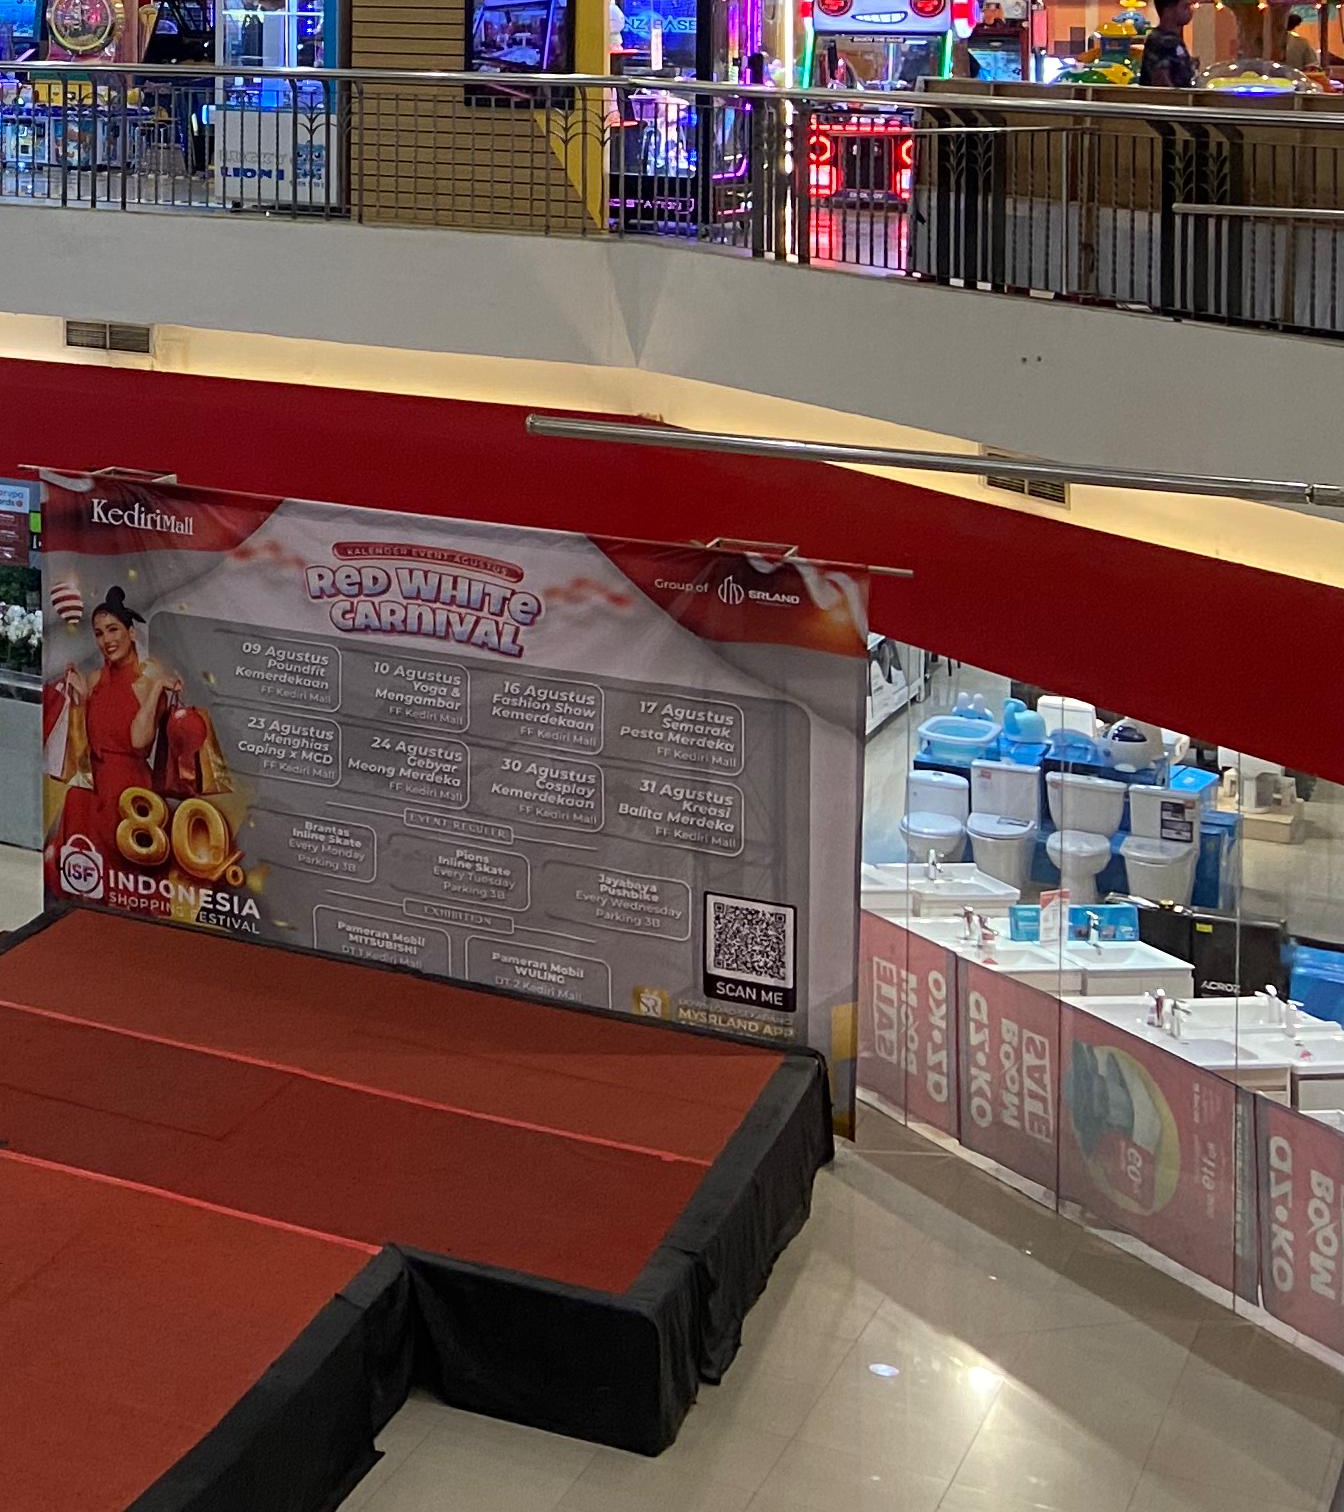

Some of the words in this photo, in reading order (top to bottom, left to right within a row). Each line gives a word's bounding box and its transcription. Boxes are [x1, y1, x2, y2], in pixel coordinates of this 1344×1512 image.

[655, 578, 693, 593] Group
[696, 582, 709, 593] of
[242, 642, 261, 654] 09
[265, 645, 329, 666] Agustus
[235, 666, 329, 689] Kemerdekaan
[268, 659, 326, 676] Poundfit
[374, 662, 390, 673] 10
[393, 665, 461, 686] Agustus
[261, 686, 273, 695] FF
[276, 687, 307, 699] Kediri
[309, 692, 332, 704] Mall
[375, 688, 461, 711] Mengambar
[413, 681, 447, 697] Yoga
[451, 687, 461, 697] &
[503, 681, 520, 694] 16
[524, 684, 595, 705] Agustus
[389, 706, 402, 715] FF
[405, 708, 437, 720] Kediri
[440, 712, 462, 725] Mall
[492, 694, 550, 711] Fashion
[555, 703, 596, 718] Show
[639, 701, 658, 714] 17
[661, 704, 734, 726] Agustus
[247, 717, 265, 729] 23
[269, 720, 334, 741] Agustus
[491, 706, 594, 731] Kemerdekaan
[662, 719, 731, 737] Semarak
[263, 733, 329, 752] Menghias
[520, 727, 533, 736] FF
[537, 728, 571, 742] Kediri
[575, 734, 596, 747] Mall
[620, 726, 663, 740] Pesta
[667, 733, 735, 752] Merdeka
[238, 741, 286, 760] Caping
[289, 751, 297, 759] x
[301, 751, 333, 765] MCD
[371, 737, 391, 749] 24
[395, 740, 462, 761] Agustus
[657, 747, 670, 756] FF
[673, 749, 708, 762] Kediri
[712, 754, 737, 767] Mall
[263, 760, 274, 768] FF
[279, 762, 310, 775] Kediri
[312, 767, 335, 779] Mall
[347, 758, 395, 777] Meong
[399, 766, 461, 787] Merdeka
[407, 756, 458, 773] Gebyar
[501, 759, 521, 772] 30
[525, 762, 596, 784] Agustus
[491, 784, 594, 809] Kemerdekaan
[535, 779, 596, 798] Cosplay
[639, 780, 656, 792] 31
[659, 784, 733, 806] Agustus
[619, 804, 662, 821] Balita
[667, 812, 735, 832] Merdeka
[682, 802, 731, 818] Kreasi
[292, 828, 327, 842] Inline
[328, 836, 362, 848] Skate
[305, 821, 350, 837] Brantas
[289, 839, 319, 853] Every
[322, 845, 365, 861] Monday
[67, 862, 96, 883] ISF
[298, 854, 339, 871] Parking
[438, 856, 472, 869] Inline
[474, 863, 511, 876] Skate
[433, 867, 464, 881] Every
[468, 872, 516, 888] Tuesday
[108, 869, 261, 919] INDONESIA
[444, 881, 487, 899] Parking
[576, 891, 609, 907] Every
[612, 896, 682, 919] Wednesday
[596, 908, 641, 927] Parking
[337, 921, 389, 939] Pameran
[391, 933, 425, 946] Mobil
[492, 952, 547, 969] Pameran
[550, 963, 584, 977] Mobil
[514, 966, 565, 984] WULING
[716, 981, 757, 1001] SCAN
[761, 990, 784, 1006] ME
[678, 1008, 759, 1033] MYSRLAND
[763, 1025, 794, 1038] APP
